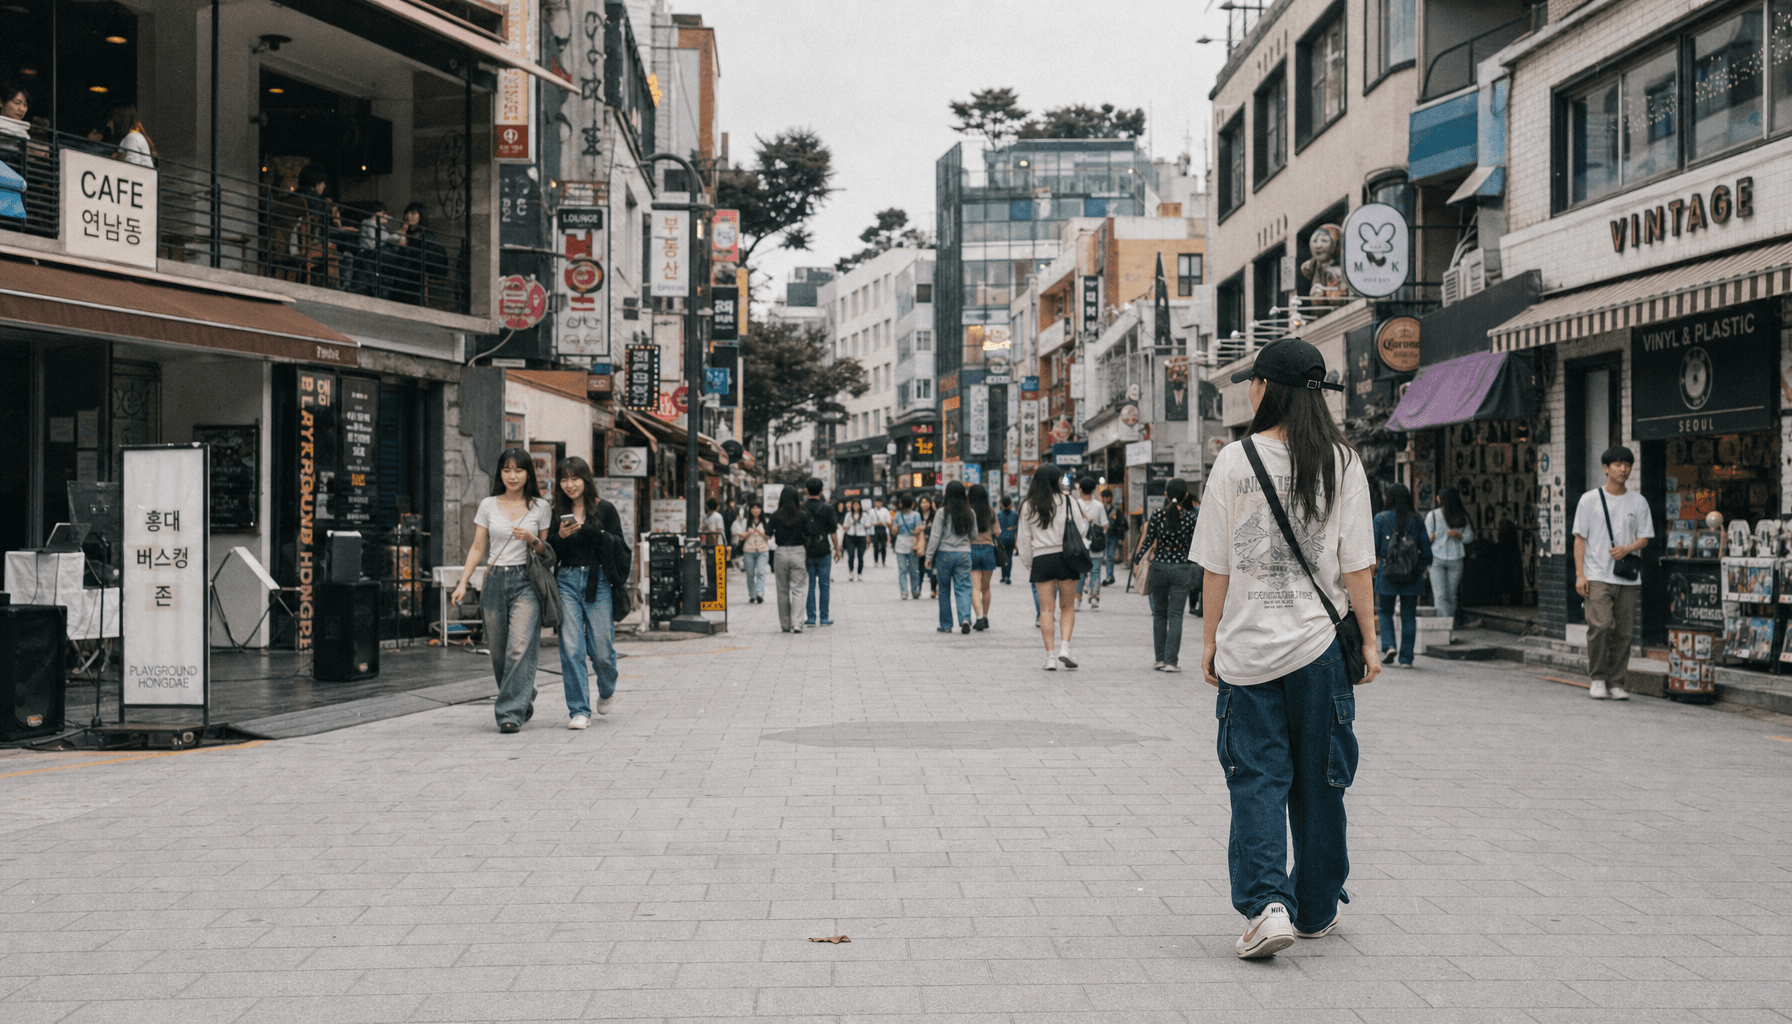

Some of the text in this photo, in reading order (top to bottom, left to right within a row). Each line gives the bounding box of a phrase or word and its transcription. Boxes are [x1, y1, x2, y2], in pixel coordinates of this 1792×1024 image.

[81, 170, 143, 209] CAFE
[1610, 176, 1753, 253] VINTAGE
[82, 209, 142, 245] 연남동
[1643, 313, 1755, 352] VINYL & PLASTIC
[1679, 418, 1714, 432] SEOUL
[145, 510, 180, 532] 홍대
[154, 585, 172, 606] 존
[130, 665, 197, 676] PLAYGROUND
[138, 677, 189, 688] HONGDAE
